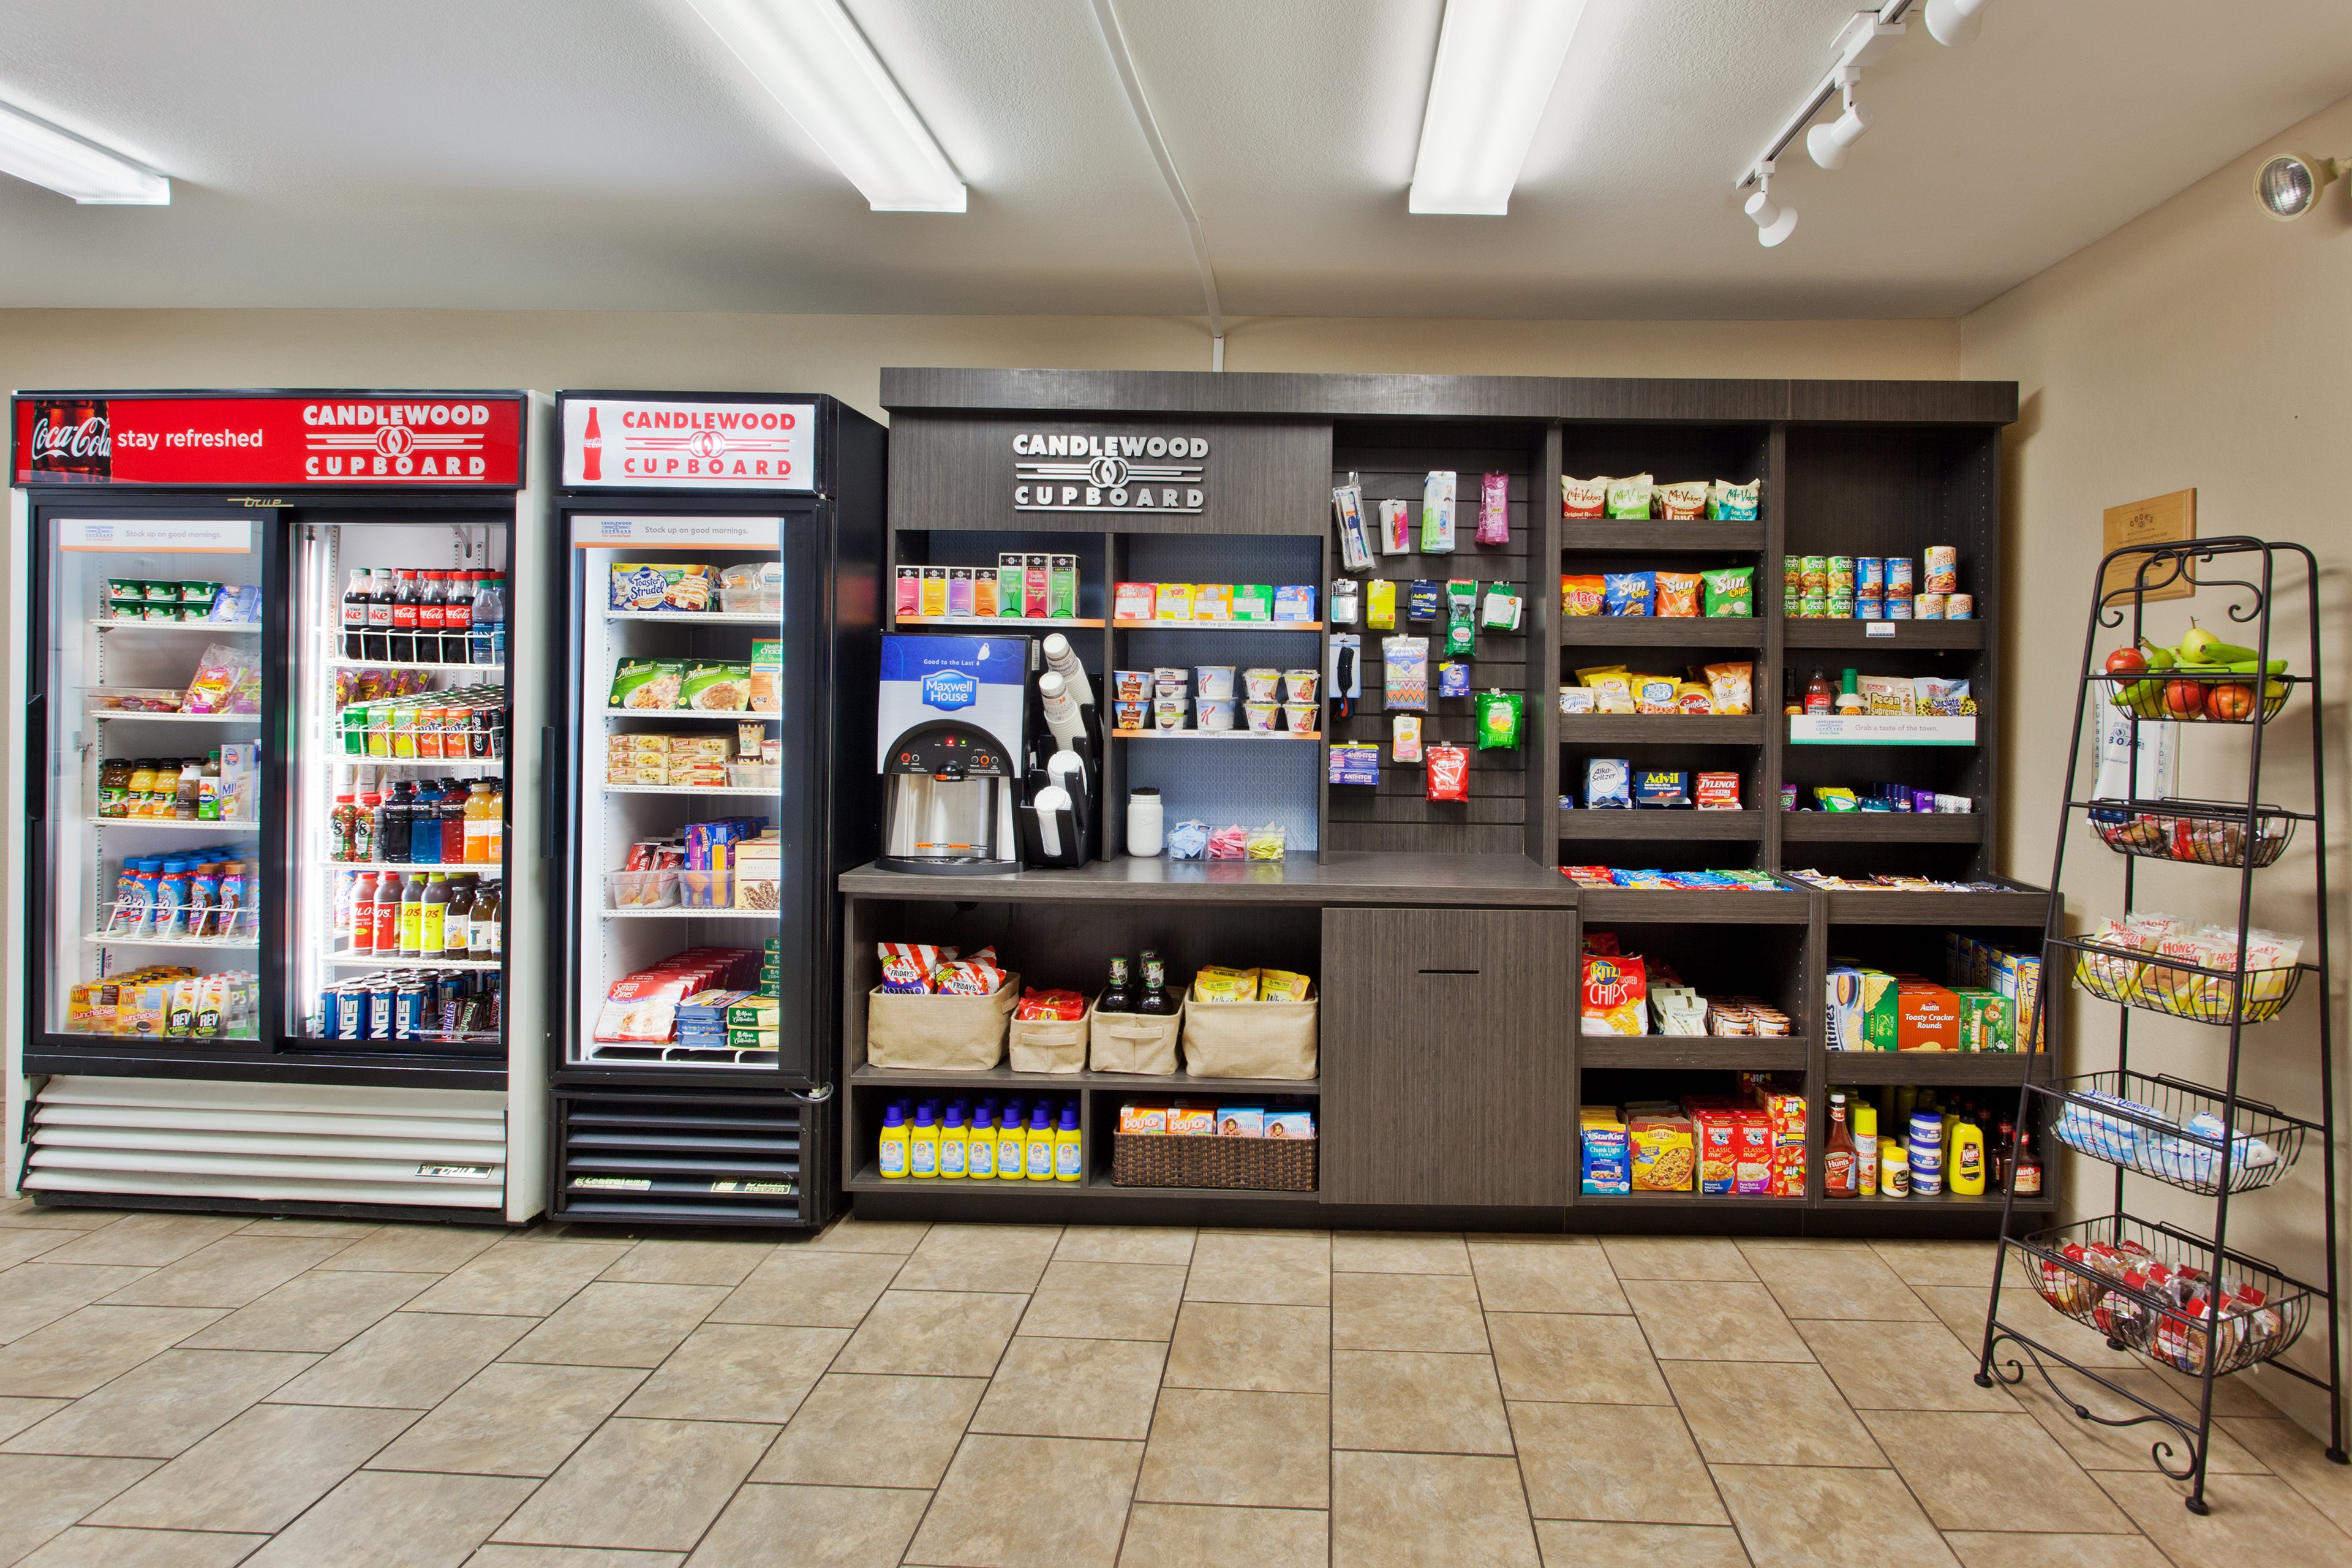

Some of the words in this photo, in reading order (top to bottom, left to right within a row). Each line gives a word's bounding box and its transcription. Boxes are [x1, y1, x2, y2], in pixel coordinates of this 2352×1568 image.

[303, 405, 489, 425] CANDLEWOOD
[622, 412, 796, 430] CANDLEWOOD
[32, 417, 111, 459] Coca-Cola
[118, 430, 159, 450] stay
[166, 429, 263, 447] refreshed
[1013, 435, 1208, 458] CANDLEWOOD
[306, 457, 485, 475] CUPBOARD
[624, 458, 791, 475] CUPBOARD
[1015, 486, 1204, 507] CUPBOARD
[2130, 513, 2154, 527] COOK'S
[168, 530, 186, 539] good
[668, 527, 677, 536] up
[691, 526, 710, 537] good
[712, 527, 748, 537] mornings.
[633, 578, 660, 587] Toaster
[1618, 581, 1646, 597] Sun
[1666, 580, 1694, 594] Sun
[1716, 576, 1746, 595] Sun
[630, 581, 665, 600] Strudel
[1171, 589, 1185, 597] POPS
[1631, 590, 1650, 599] Chips
[1678, 588, 1696, 598] Chips
[1729, 585, 1749, 598] Chips
[1569, 590, 1603, 605] Mac's
[1950, 601, 1969, 609] HOME
[616, 664, 654, 679] Michelina's
[684, 667, 722, 682] Michelina's
[1604, 680, 1621, 690] Lay's
[1720, 675, 1736, 684] Lay's
[926, 680, 973, 693] Maxwell
[1648, 684, 1669, 692] ROLD
[930, 691, 968, 703] House
[1646, 690, 1670, 699] GOLD
[1871, 693, 1901, 704] Pecan
[1931, 696, 1961, 709] Chocolate
[1871, 707, 1902, 716] Supremes
[1646, 773, 1679, 783] Advil
[1700, 778, 1736, 788] TYLENOL
[222, 782, 244, 796] MILK
[2122, 932, 2146, 946] BUN
[2163, 941, 2197, 956] HONEY
[1591, 962, 1619, 981] RITZ
[1619, 976, 1637, 984] TOASTED
[613, 983, 639, 992] Smart
[1590, 984, 1627, 1005] CHIPS
[2199, 994, 2225, 1003] Duchess
[73, 1007, 116, 1020] Lunchables
[123, 1012, 160, 1022] Lunchables
[173, 1013, 191, 1027] REV
[199, 1013, 218, 1027] REV
[1971, 1008, 1982, 1042] ANIMAL
[2089, 1089, 2117, 1101] SUGAR
[2117, 1098, 2152, 1113] DONUTS
[1123, 1117, 1159, 1129] bounce
[1170, 1118, 1205, 1131] bounce
[1236, 1121, 1259, 1130] Downy
[2083, 1136, 2106, 1150] Duchess
[1828, 1159, 1850, 1168] Hunt's
